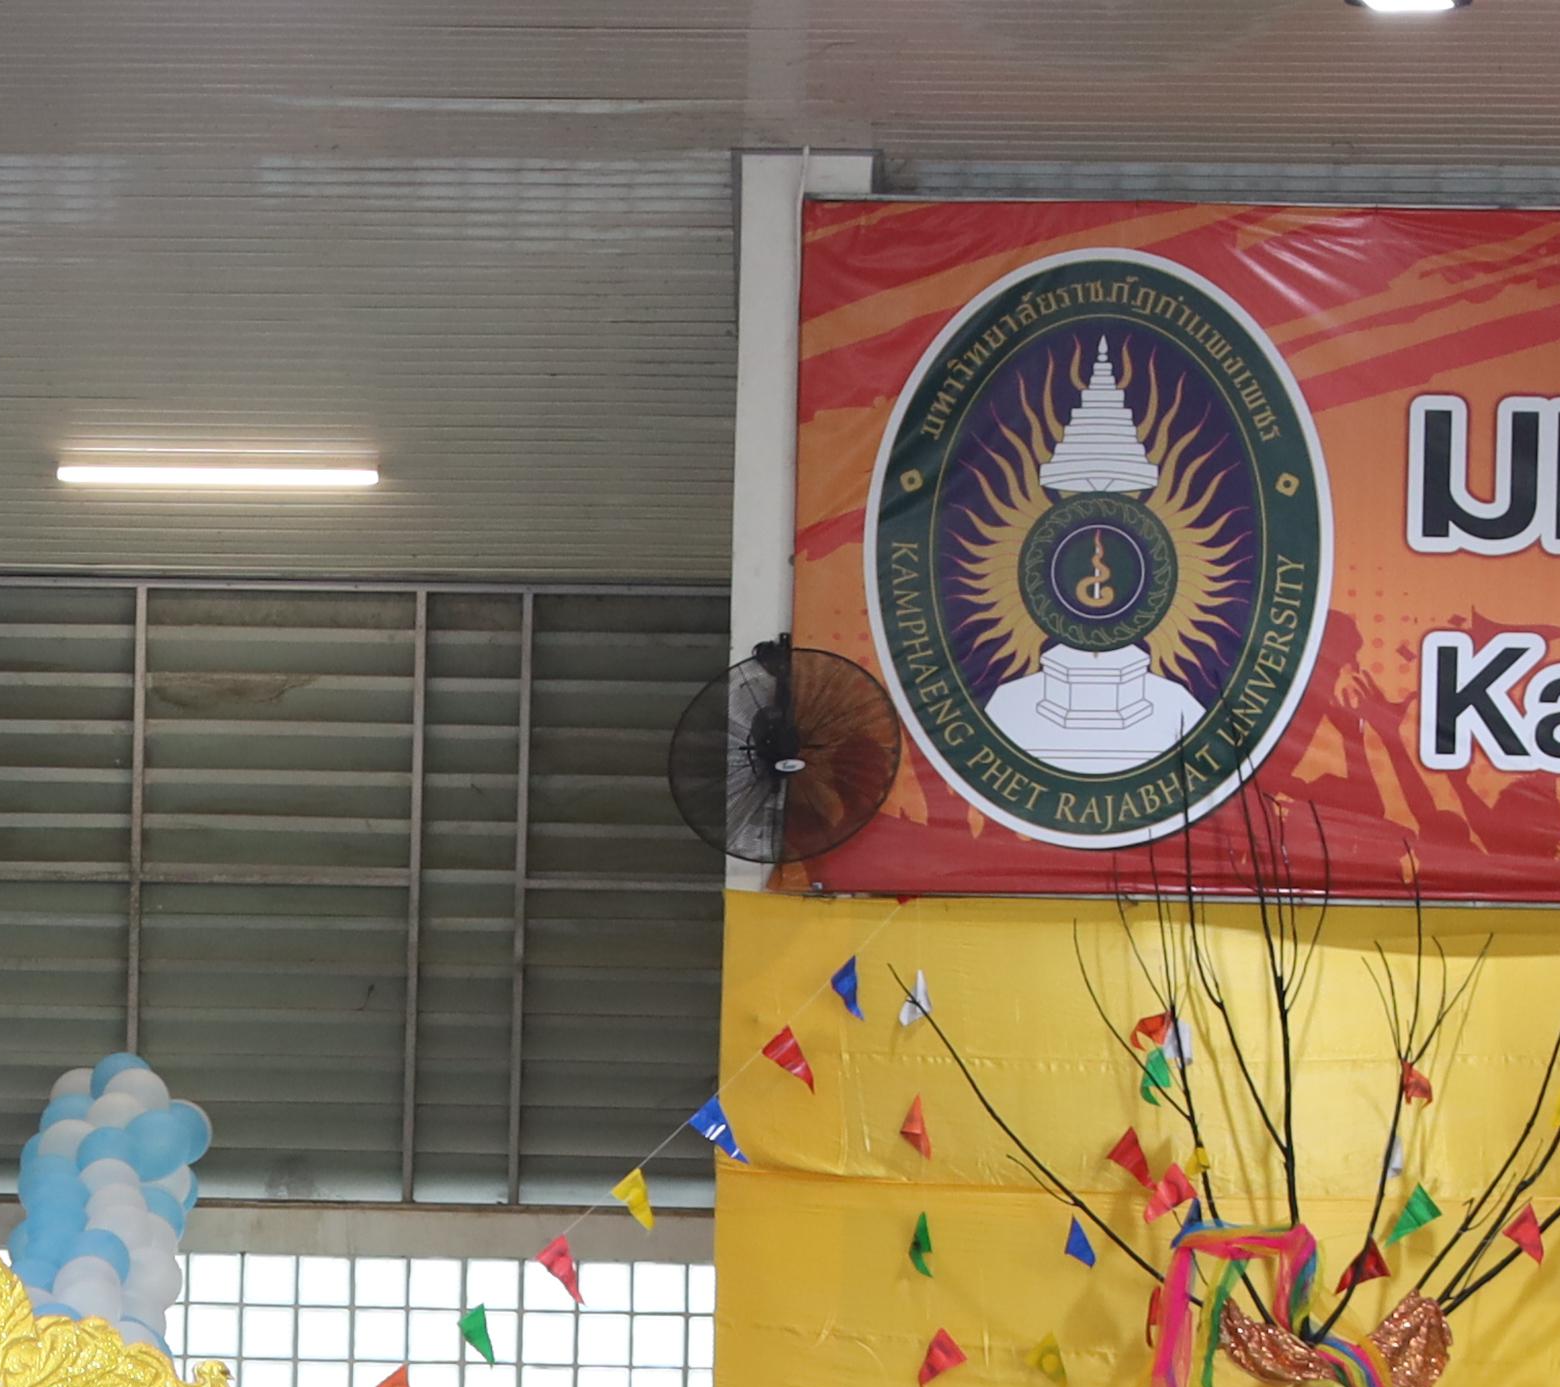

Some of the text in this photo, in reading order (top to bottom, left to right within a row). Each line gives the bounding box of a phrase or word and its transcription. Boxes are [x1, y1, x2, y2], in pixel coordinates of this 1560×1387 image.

[889, 540, 1306, 833] KAMPHAENG PHET RAJABHAT UNIVERSITY
